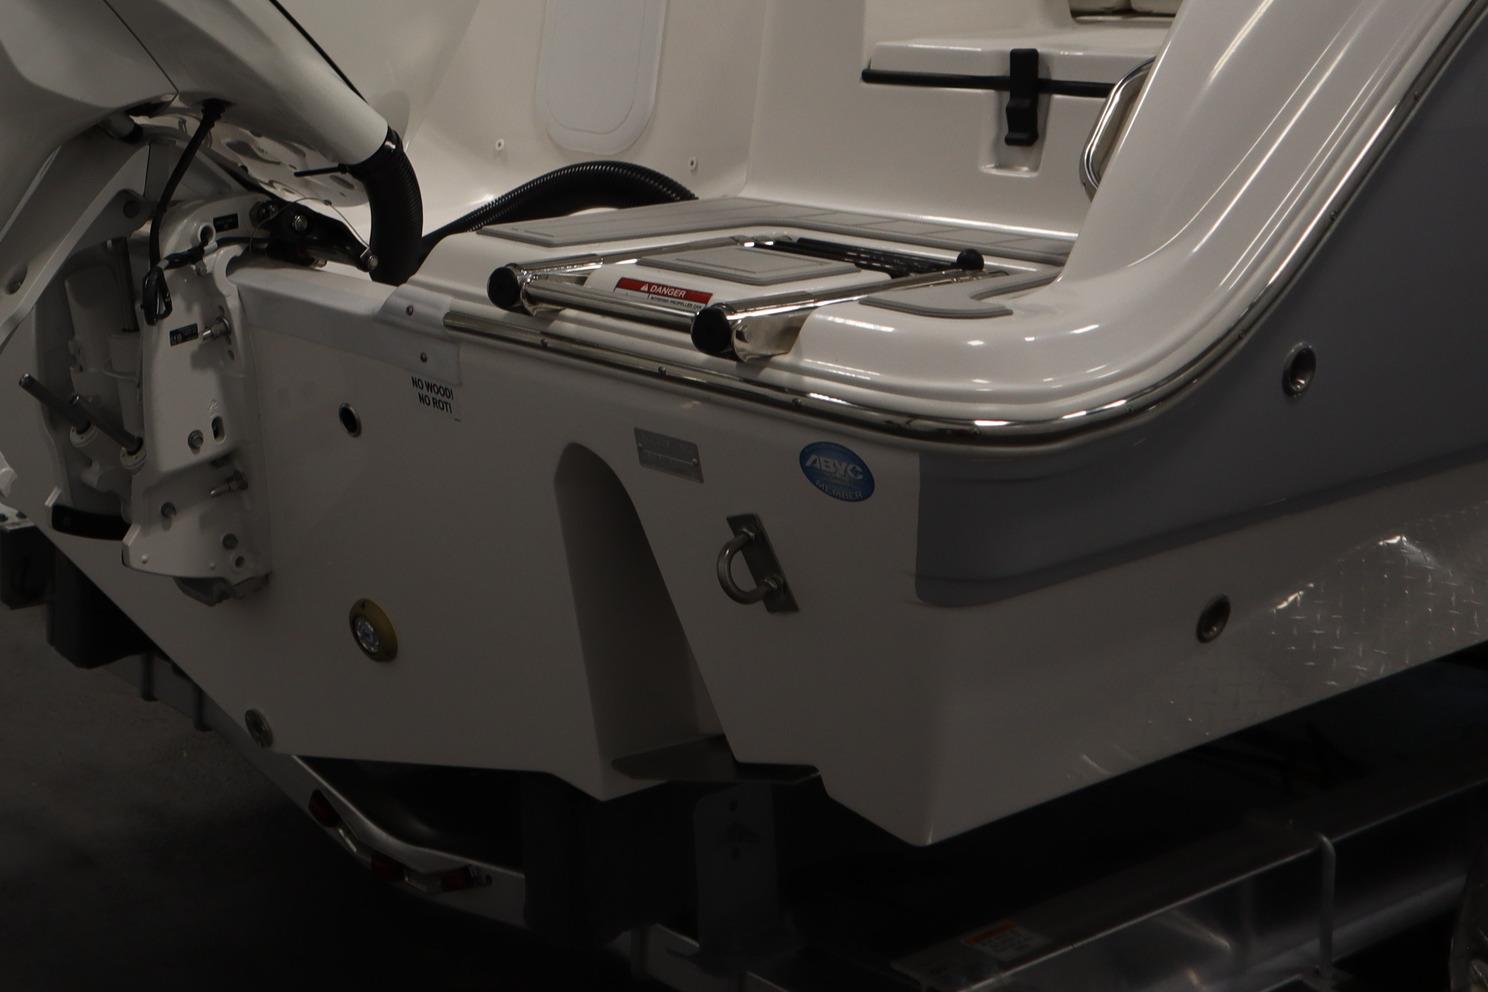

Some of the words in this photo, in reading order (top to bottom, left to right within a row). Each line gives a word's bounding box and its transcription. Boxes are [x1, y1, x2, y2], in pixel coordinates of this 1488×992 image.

[650, 284, 685, 298] DANGER
[411, 376, 423, 390] NO
[424, 380, 454, 400] WOOD!
[418, 392, 430, 405] NO
[432, 397, 452, 413] ROT!
[805, 454, 864, 480] ABYC
